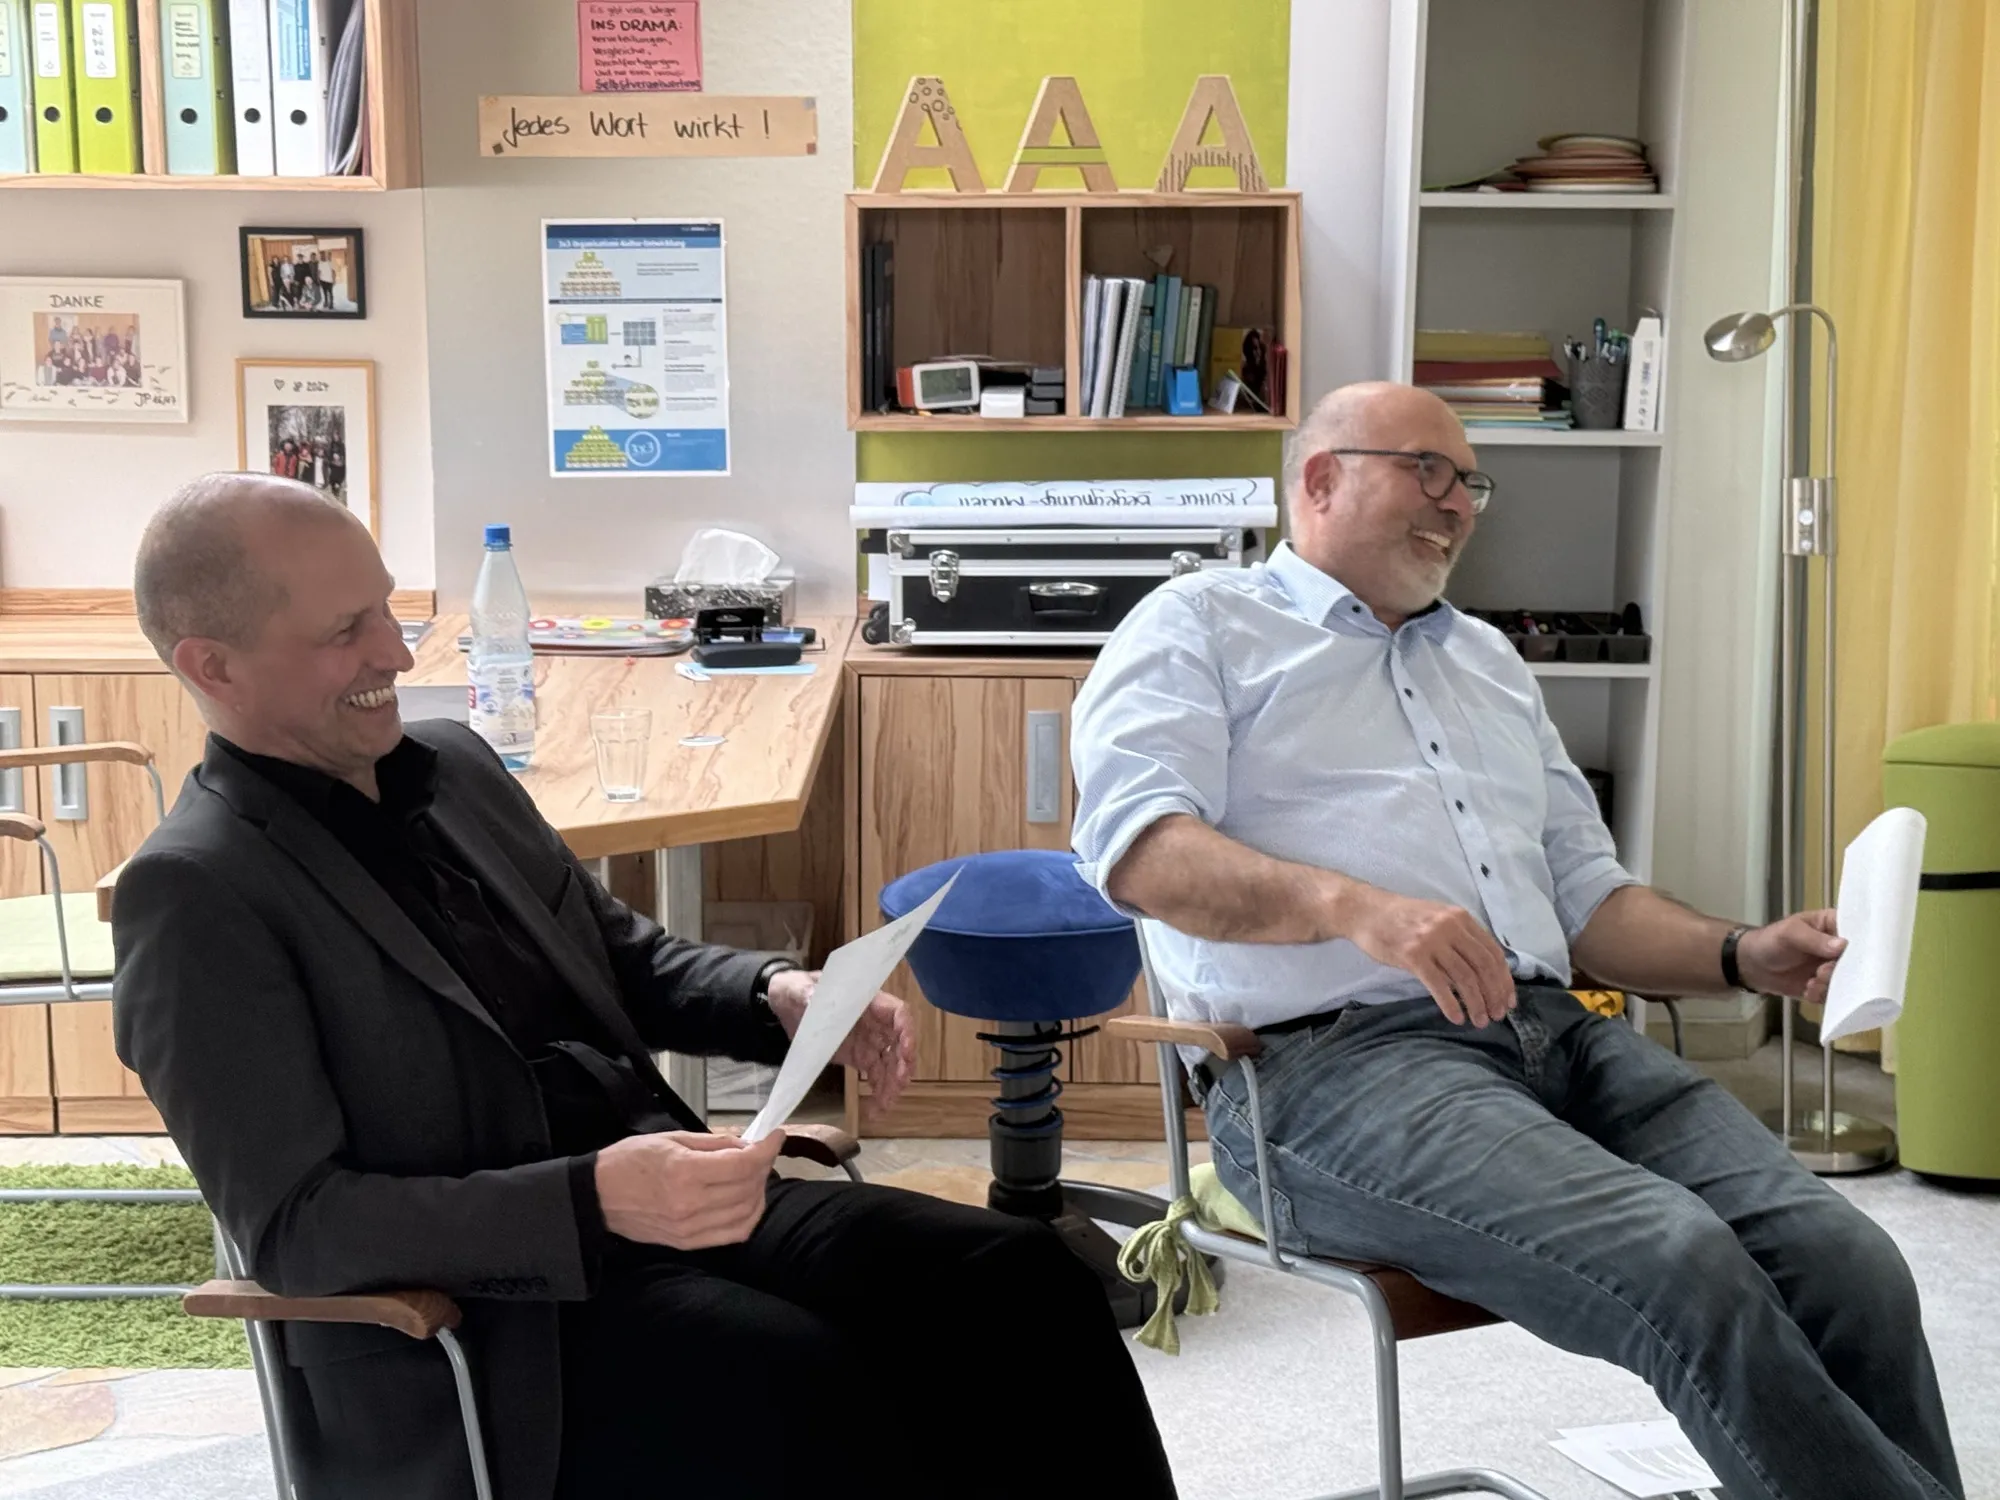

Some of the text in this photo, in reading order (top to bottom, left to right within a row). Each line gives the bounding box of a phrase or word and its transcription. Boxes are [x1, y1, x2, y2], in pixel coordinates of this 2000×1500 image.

[591, 19, 683, 33] INS DRAMA:
[503, 107, 571, 149] Jedes
[590, 111, 649, 139] Wort
[673, 113, 744, 139] wirkt
[872, 74, 1271, 193] A A A
[49, 294, 105, 309] DANKE
